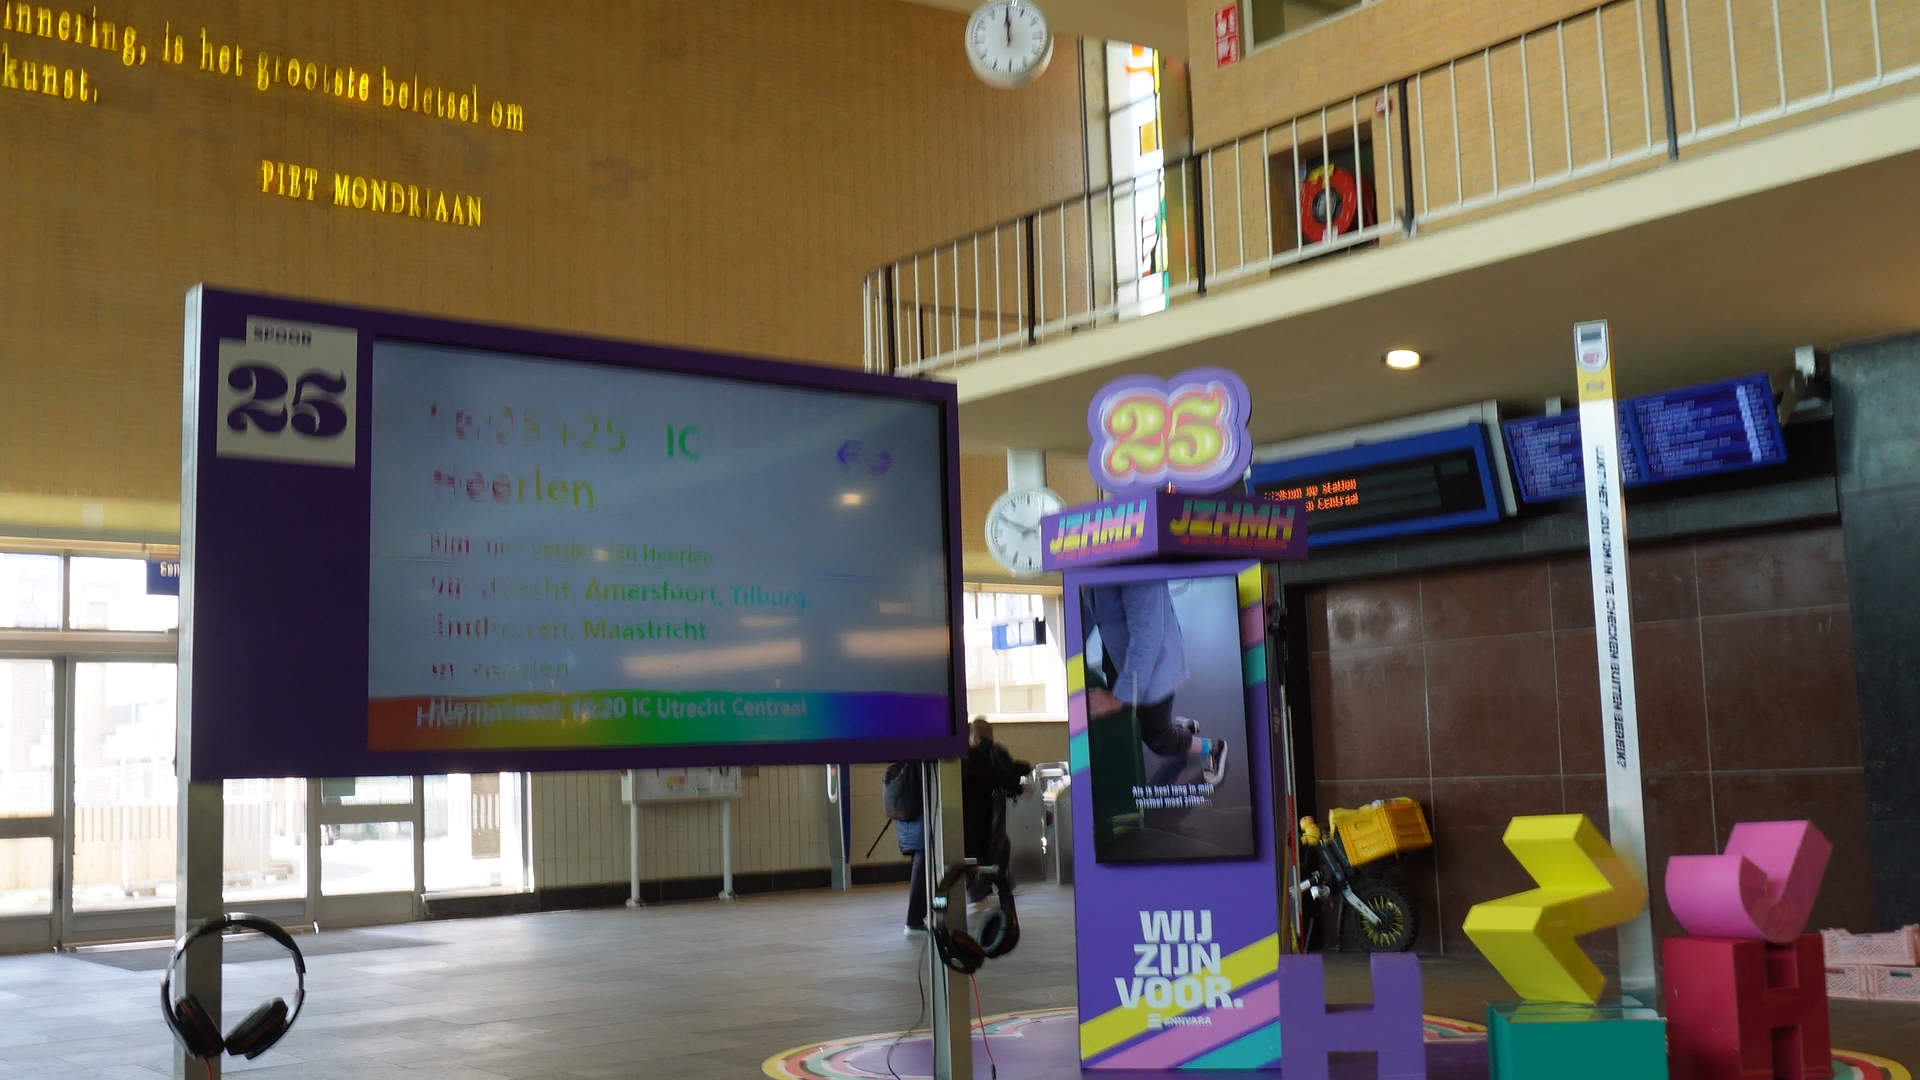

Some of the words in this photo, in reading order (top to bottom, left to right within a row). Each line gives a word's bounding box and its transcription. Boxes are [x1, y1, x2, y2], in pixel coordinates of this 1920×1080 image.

[162, 20, 184, 65] is
[199, 26, 243, 77] het
[256, 51, 369, 102] grootste
[381, 65, 480, 124] beletsel
[490, 100, 525, 133] om
[261, 159, 318, 202] PIET
[333, 172, 483, 229] MONDRIAAN
[226, 362, 349, 440] 25
[665, 423, 701, 460] IC
[1108, 396, 1222, 474] 25
[582, 615, 708, 642] Maastricht
[1610, 662, 1624, 711] BUITEN
[656, 697, 727, 720] Utrecht
[731, 694, 808, 718] Centraal
[1139, 909, 1213, 944] WIJ
[1133, 942, 1222, 978] ZIJN
[1114, 976, 1245, 1011] VOOR.
